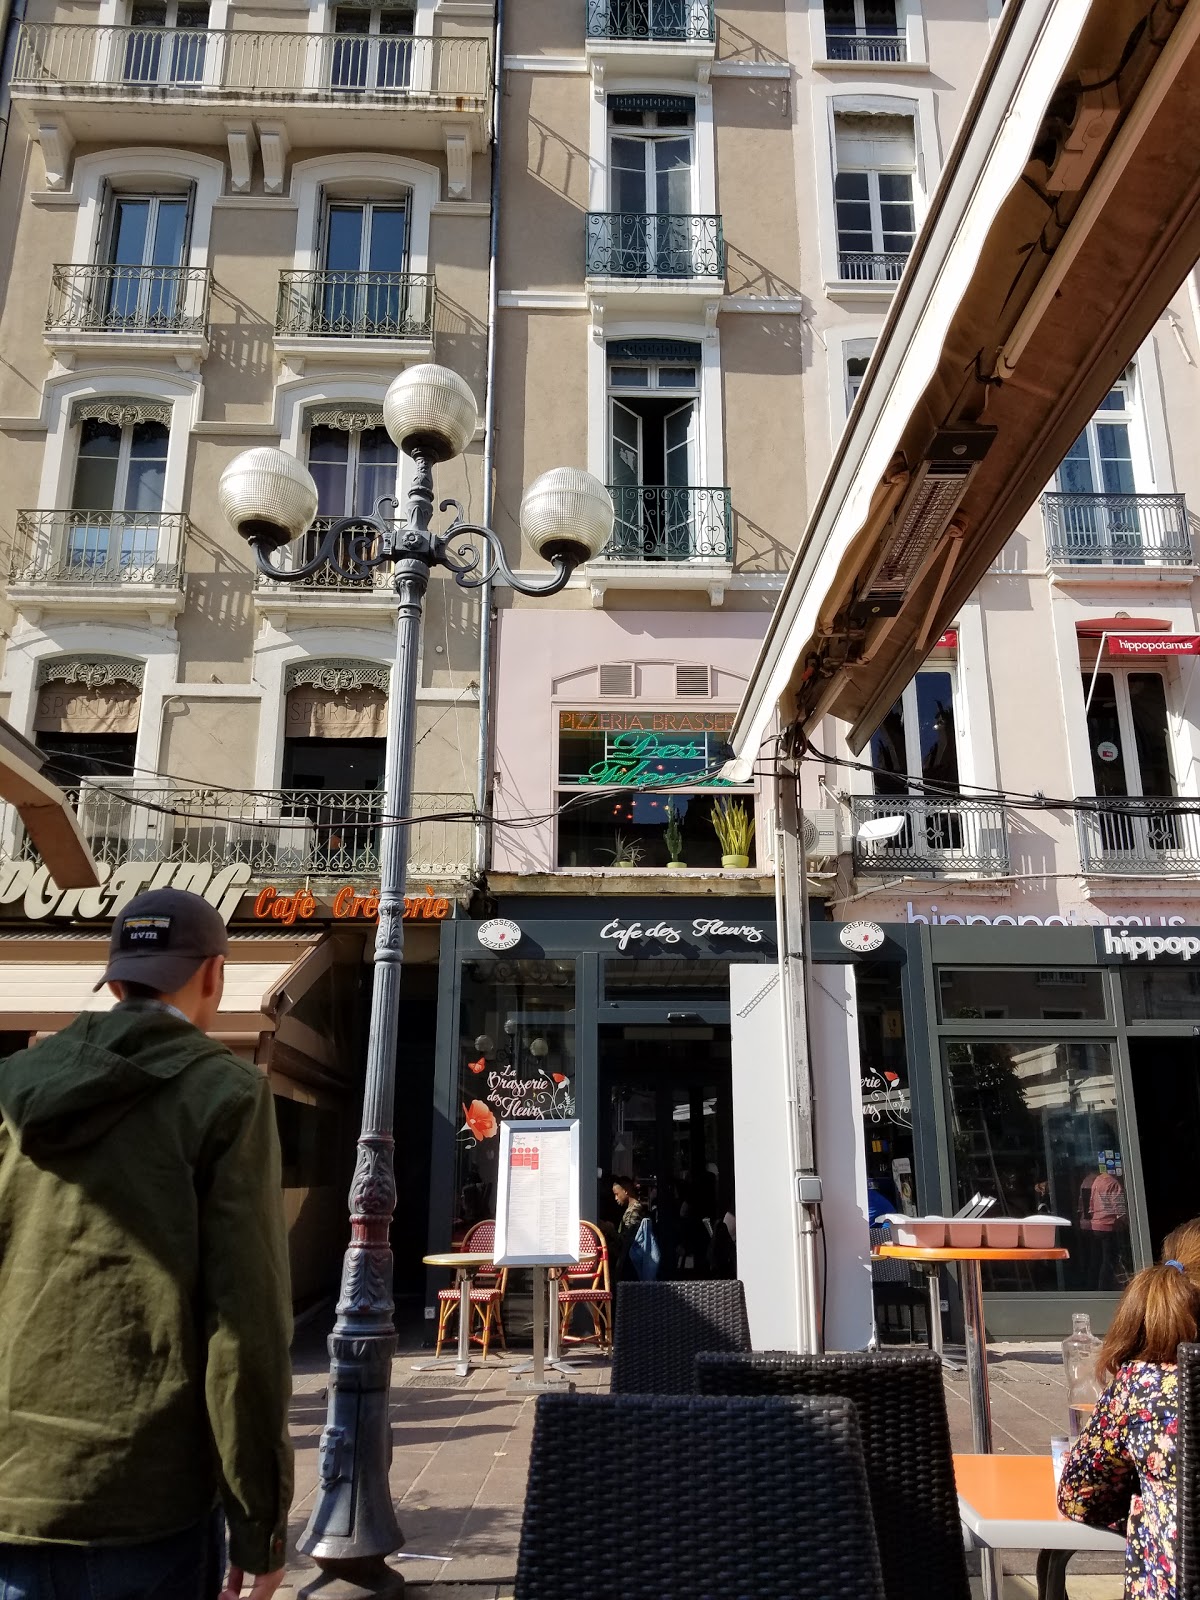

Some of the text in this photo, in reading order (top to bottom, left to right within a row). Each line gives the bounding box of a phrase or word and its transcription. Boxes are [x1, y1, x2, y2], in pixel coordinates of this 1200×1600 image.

[1118, 639, 1194, 653] hippopotamus
[290, 702, 386, 721] SPORTING
[559, 713, 644, 731] PIZZERIA
[612, 731, 700, 759] Des
[333, 885, 449, 925] Crêerie
[130, 931, 158, 940] uvm
[479, 919, 520, 934] BRASSERIE
[644, 921, 682, 943] des
[692, 918, 764, 943] Fleurs
[480, 936, 519, 949] PIZZERIA
[845, 939, 883, 951] GLACIER
[500, 1064, 517, 1077] La
[487, 1071, 548, 1098] Brasserie
[486, 1089, 504, 1107] des
